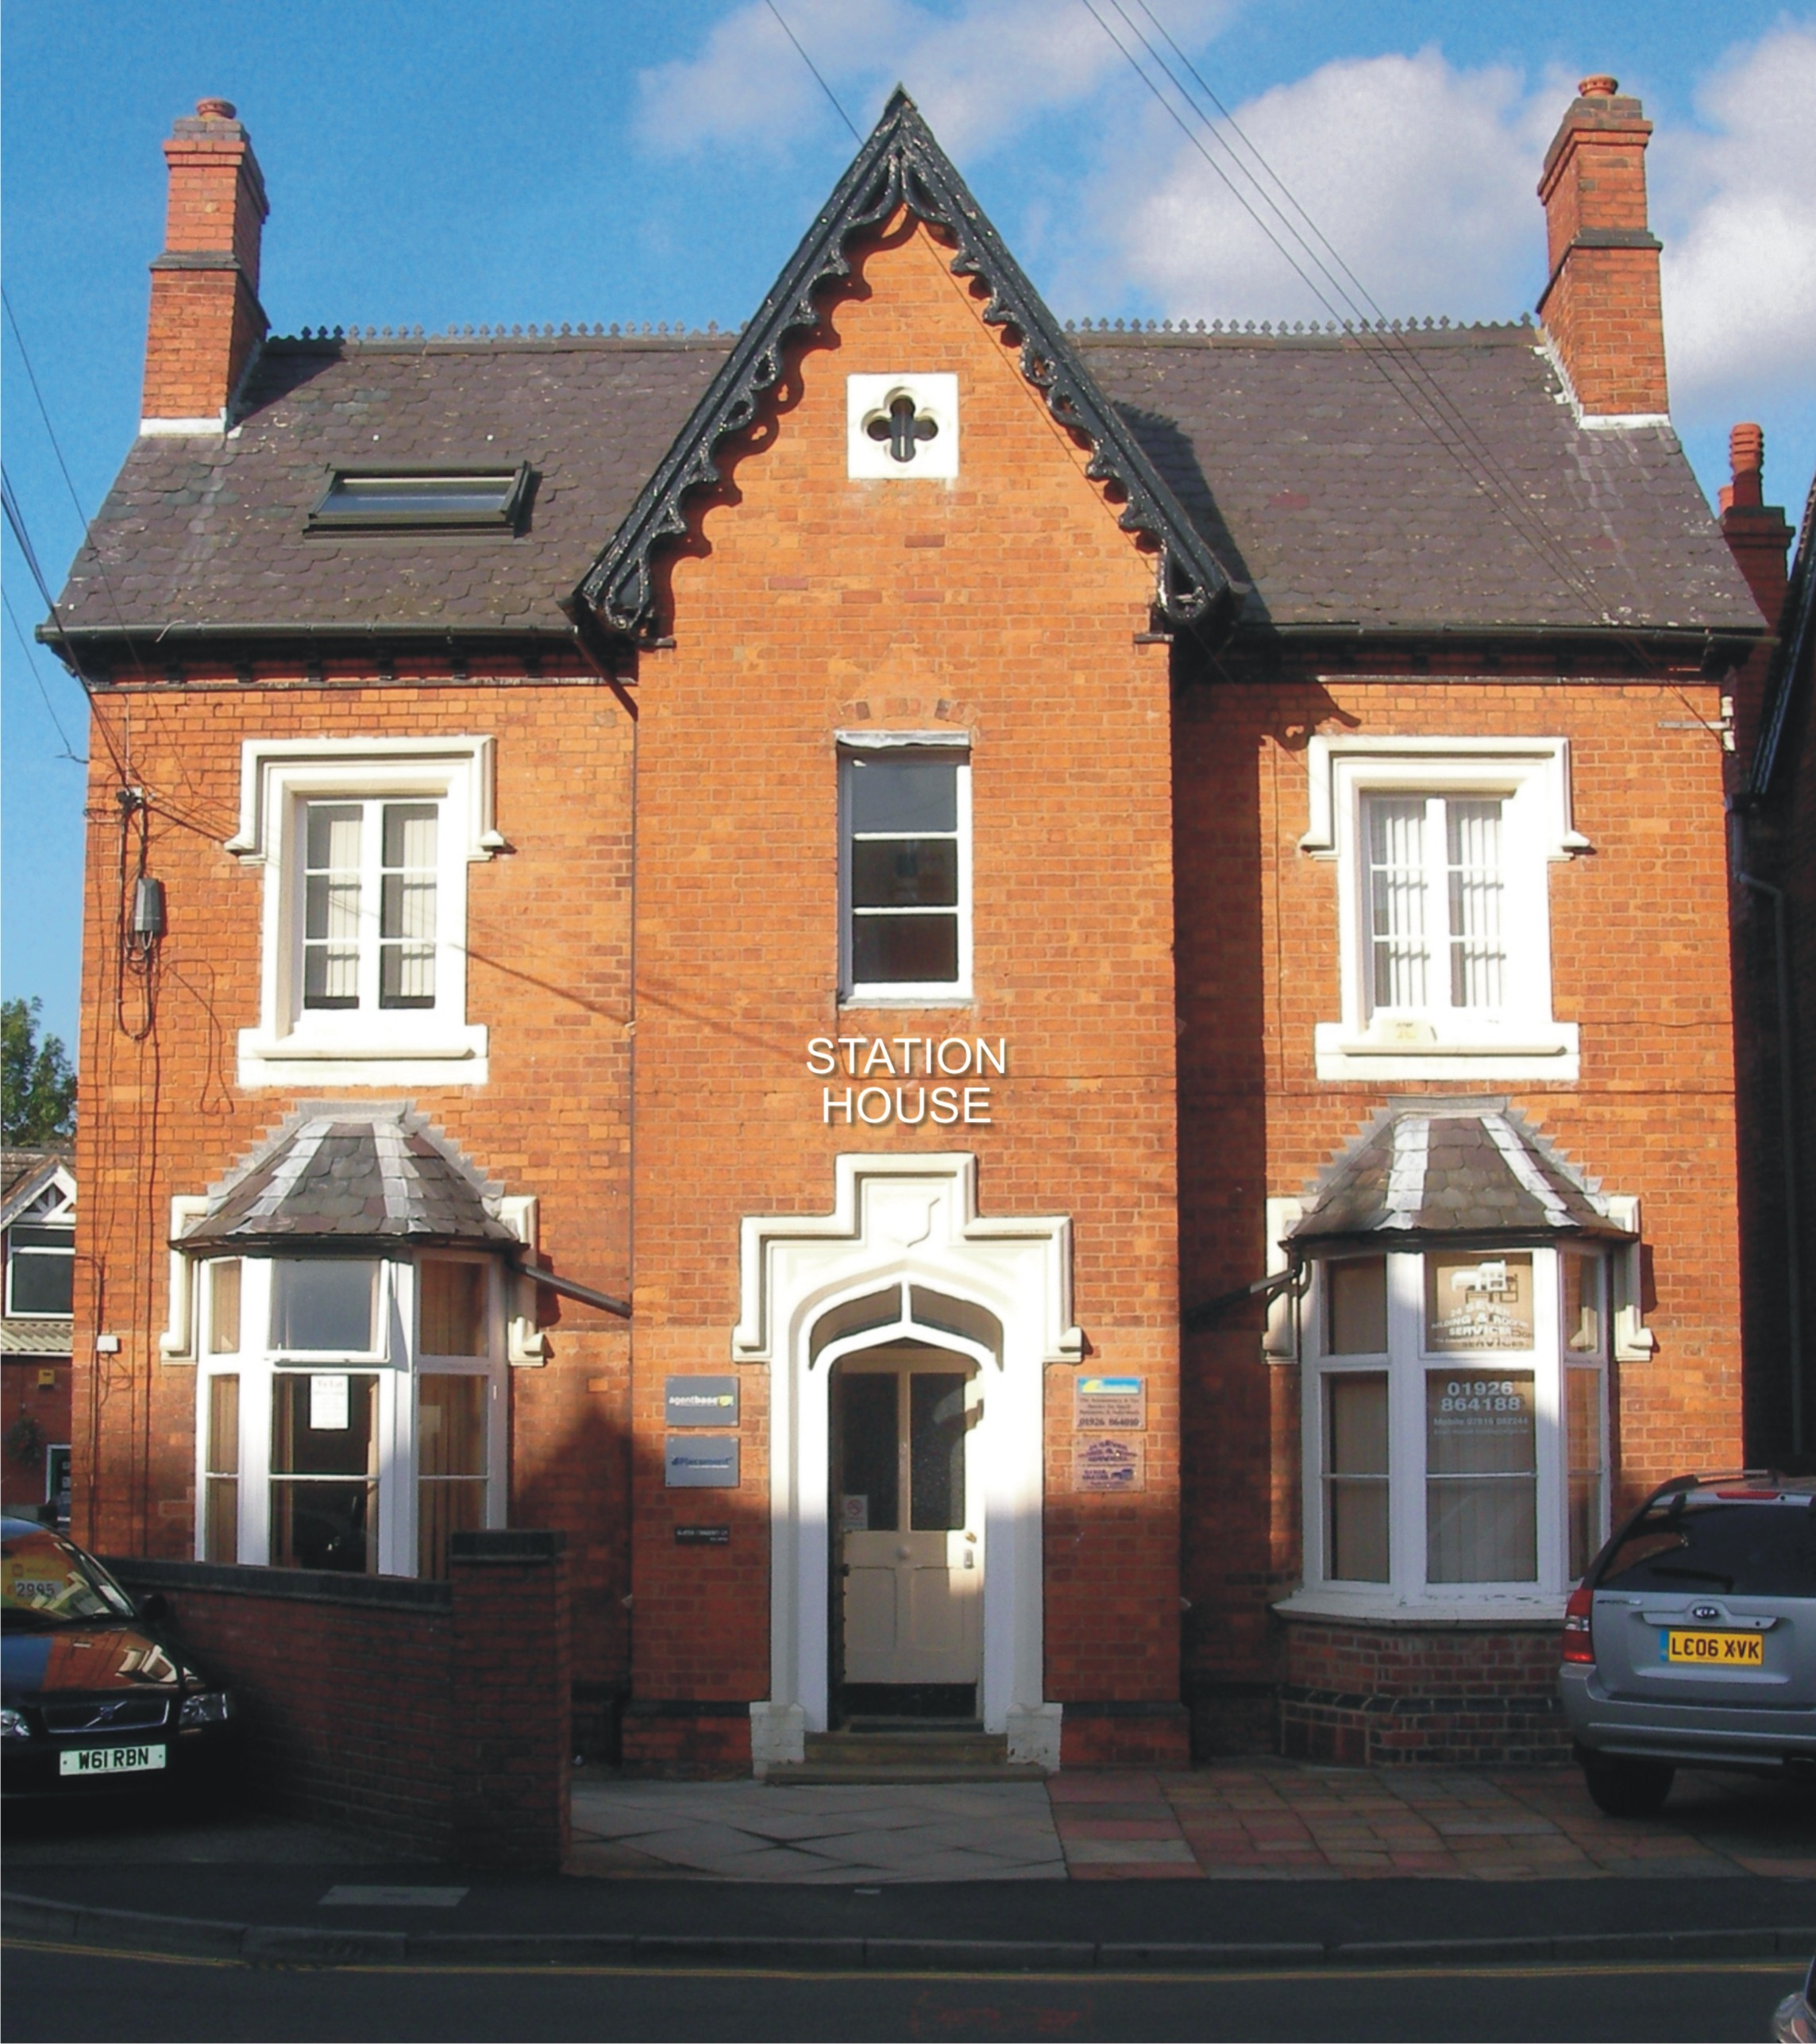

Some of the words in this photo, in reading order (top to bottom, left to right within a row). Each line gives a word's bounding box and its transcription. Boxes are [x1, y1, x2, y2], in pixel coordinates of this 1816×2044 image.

[1477, 1312, 1487, 1323] &
[1447, 1381, 1513, 1396] 01926
[1440, 1397, 1521, 1411] 864188
[1695, 1608, 1715, 1617] KIA
[1671, 1637, 1718, 1657] LE06
[1724, 1640, 1760, 1659] XVK
[79, 1750, 108, 1769] W61
[114, 1747, 149, 1768] RBN
